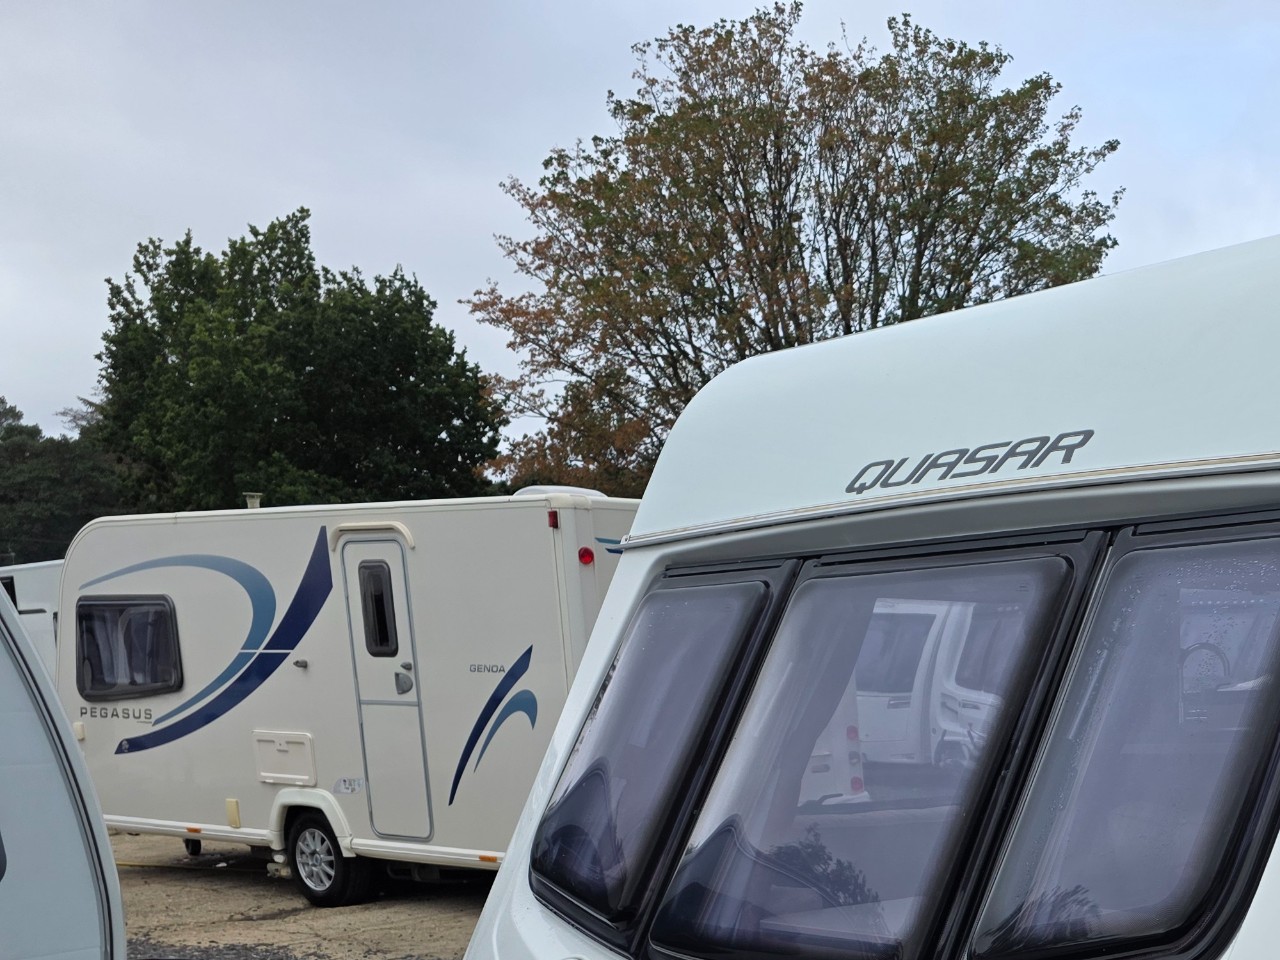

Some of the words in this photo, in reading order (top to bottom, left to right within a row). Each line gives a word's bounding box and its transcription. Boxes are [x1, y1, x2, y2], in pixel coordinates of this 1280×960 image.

[845, 429, 1095, 494] QUASAR
[469, 663, 506, 673] GENOA
[80, 706, 152, 720] PEGASUS
